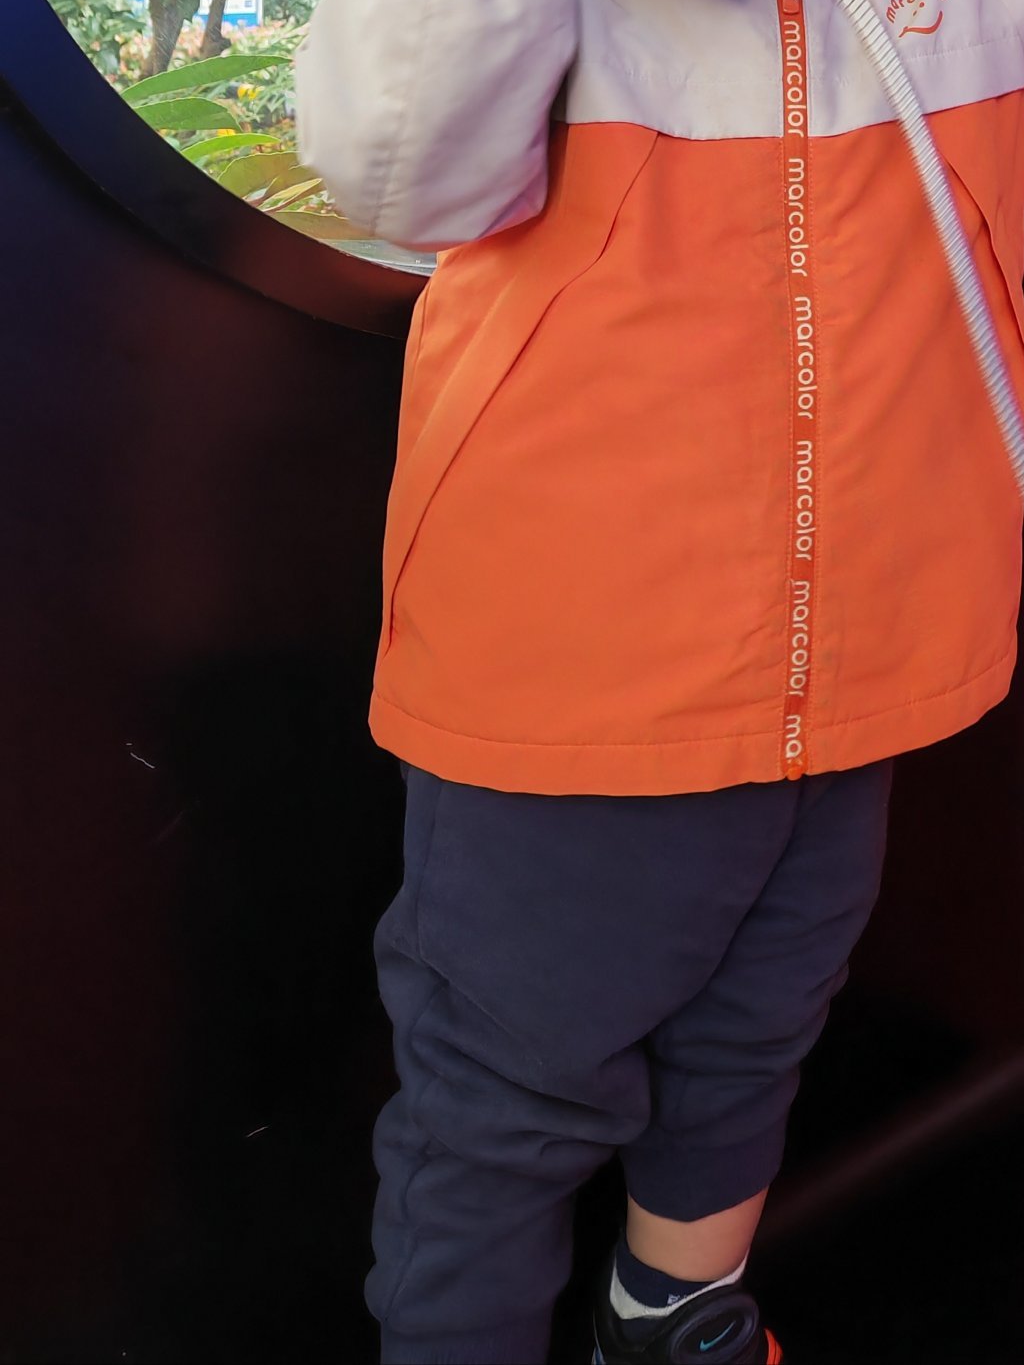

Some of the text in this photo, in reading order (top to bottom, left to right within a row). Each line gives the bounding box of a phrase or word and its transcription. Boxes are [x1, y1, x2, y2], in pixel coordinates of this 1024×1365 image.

[784, 20, 807, 138] marcolor
[787, 158, 809, 277] marcolor
[794, 296, 818, 420] marcolor
[795, 440, 817, 561] marcolor
[789, 580, 810, 697] marcolor
